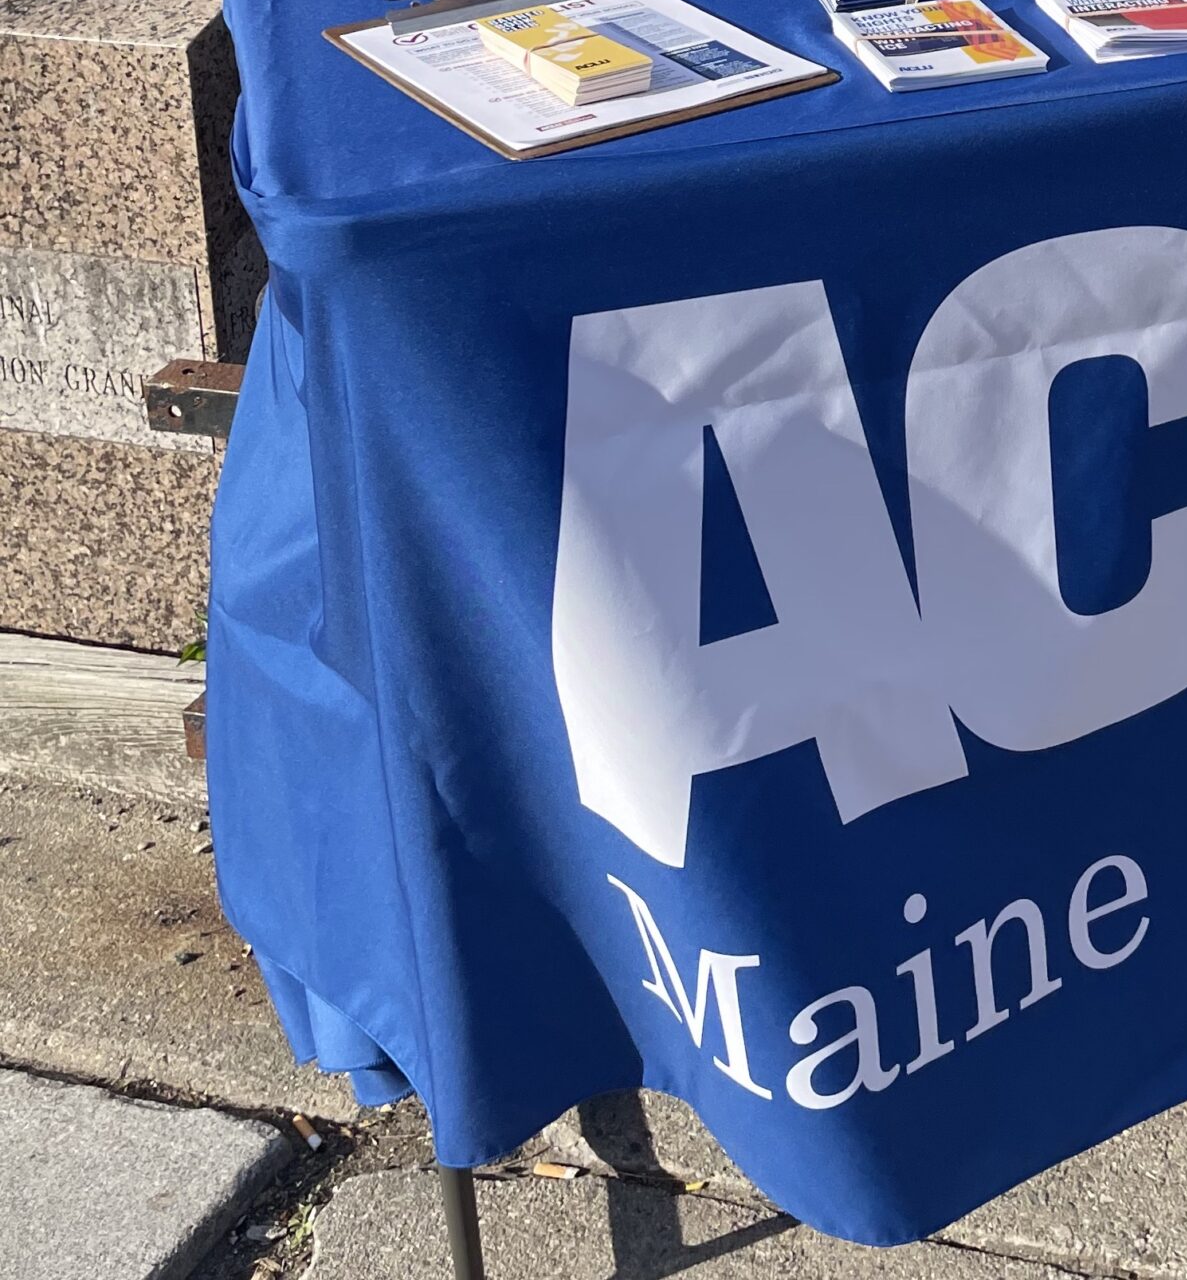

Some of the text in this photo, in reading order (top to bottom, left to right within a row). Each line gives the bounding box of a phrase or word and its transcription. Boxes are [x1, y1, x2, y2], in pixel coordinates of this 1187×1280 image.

[851, 6, 943, 23] KNOW YOUR
[856, 16, 914, 28] RIGHTS
[859, 23, 909, 35] WHEN
[880, 42, 907, 51] ICE
[575, 58, 611, 71] ACLU
[606, 854, 1150, 1110] Maine
